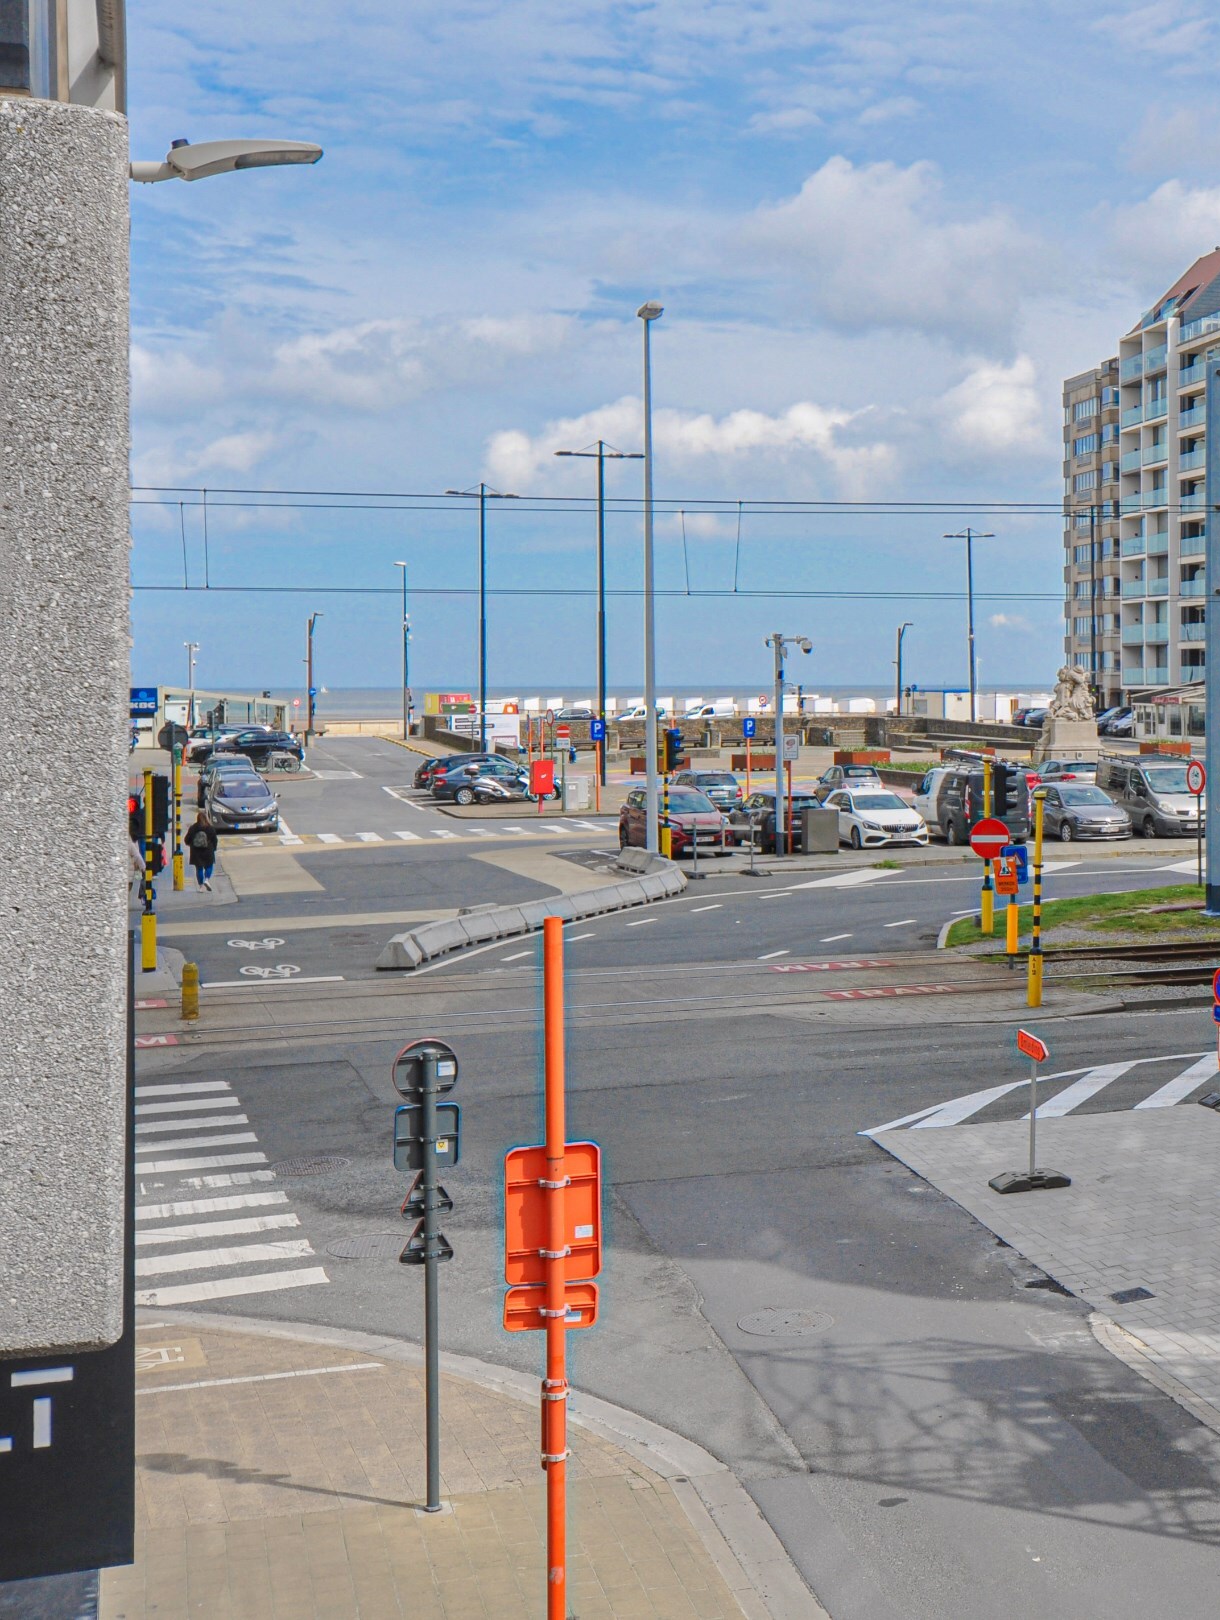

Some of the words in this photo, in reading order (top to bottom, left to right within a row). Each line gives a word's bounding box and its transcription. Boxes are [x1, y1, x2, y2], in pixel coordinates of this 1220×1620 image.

[594, 722, 602, 733] P
[746, 720, 753, 731] P
[830, 983, 952, 998] TRAM
